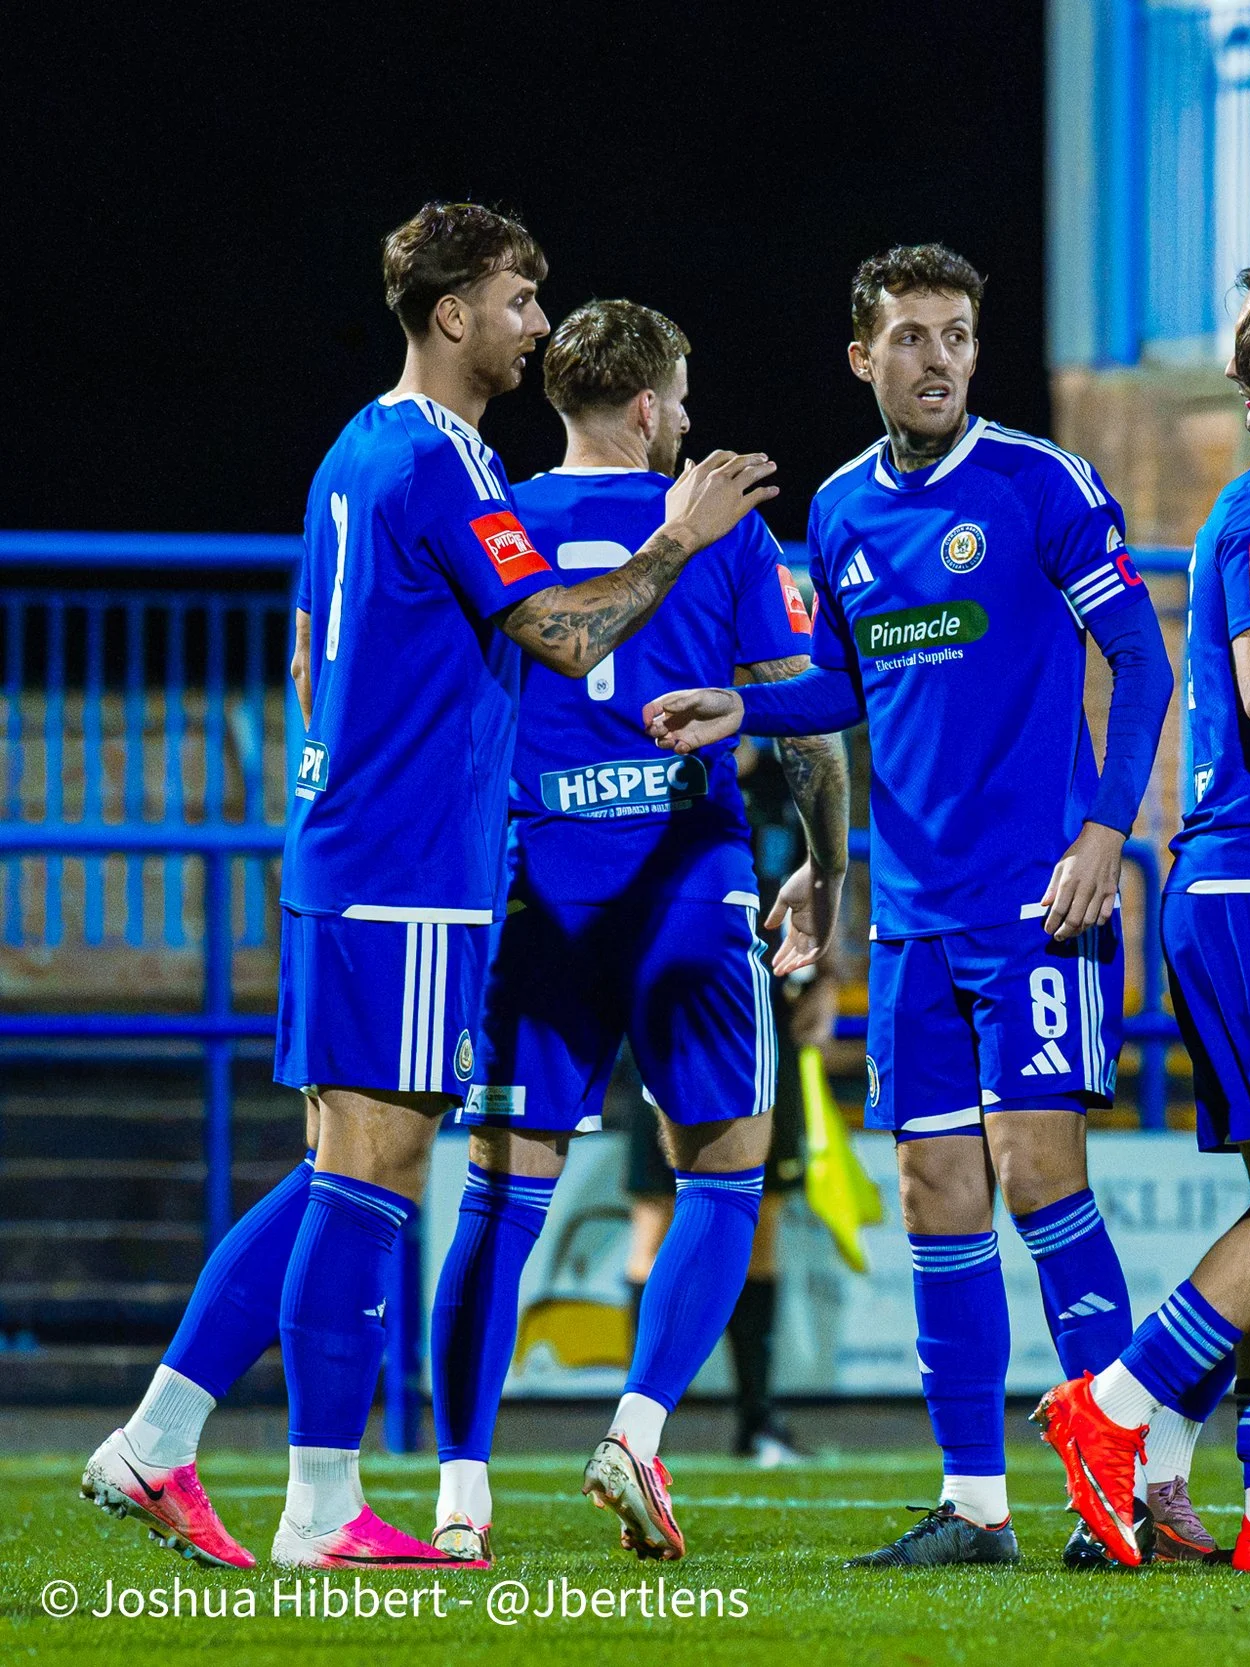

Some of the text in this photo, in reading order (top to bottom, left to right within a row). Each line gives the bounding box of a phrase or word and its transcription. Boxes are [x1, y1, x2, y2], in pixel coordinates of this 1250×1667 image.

[871, 611, 960, 649] Pinnacle
[875, 648, 964, 672] Electrical Supplies
[558, 760, 689, 812] HiSPEC
[1029, 966, 1068, 1039] 8
